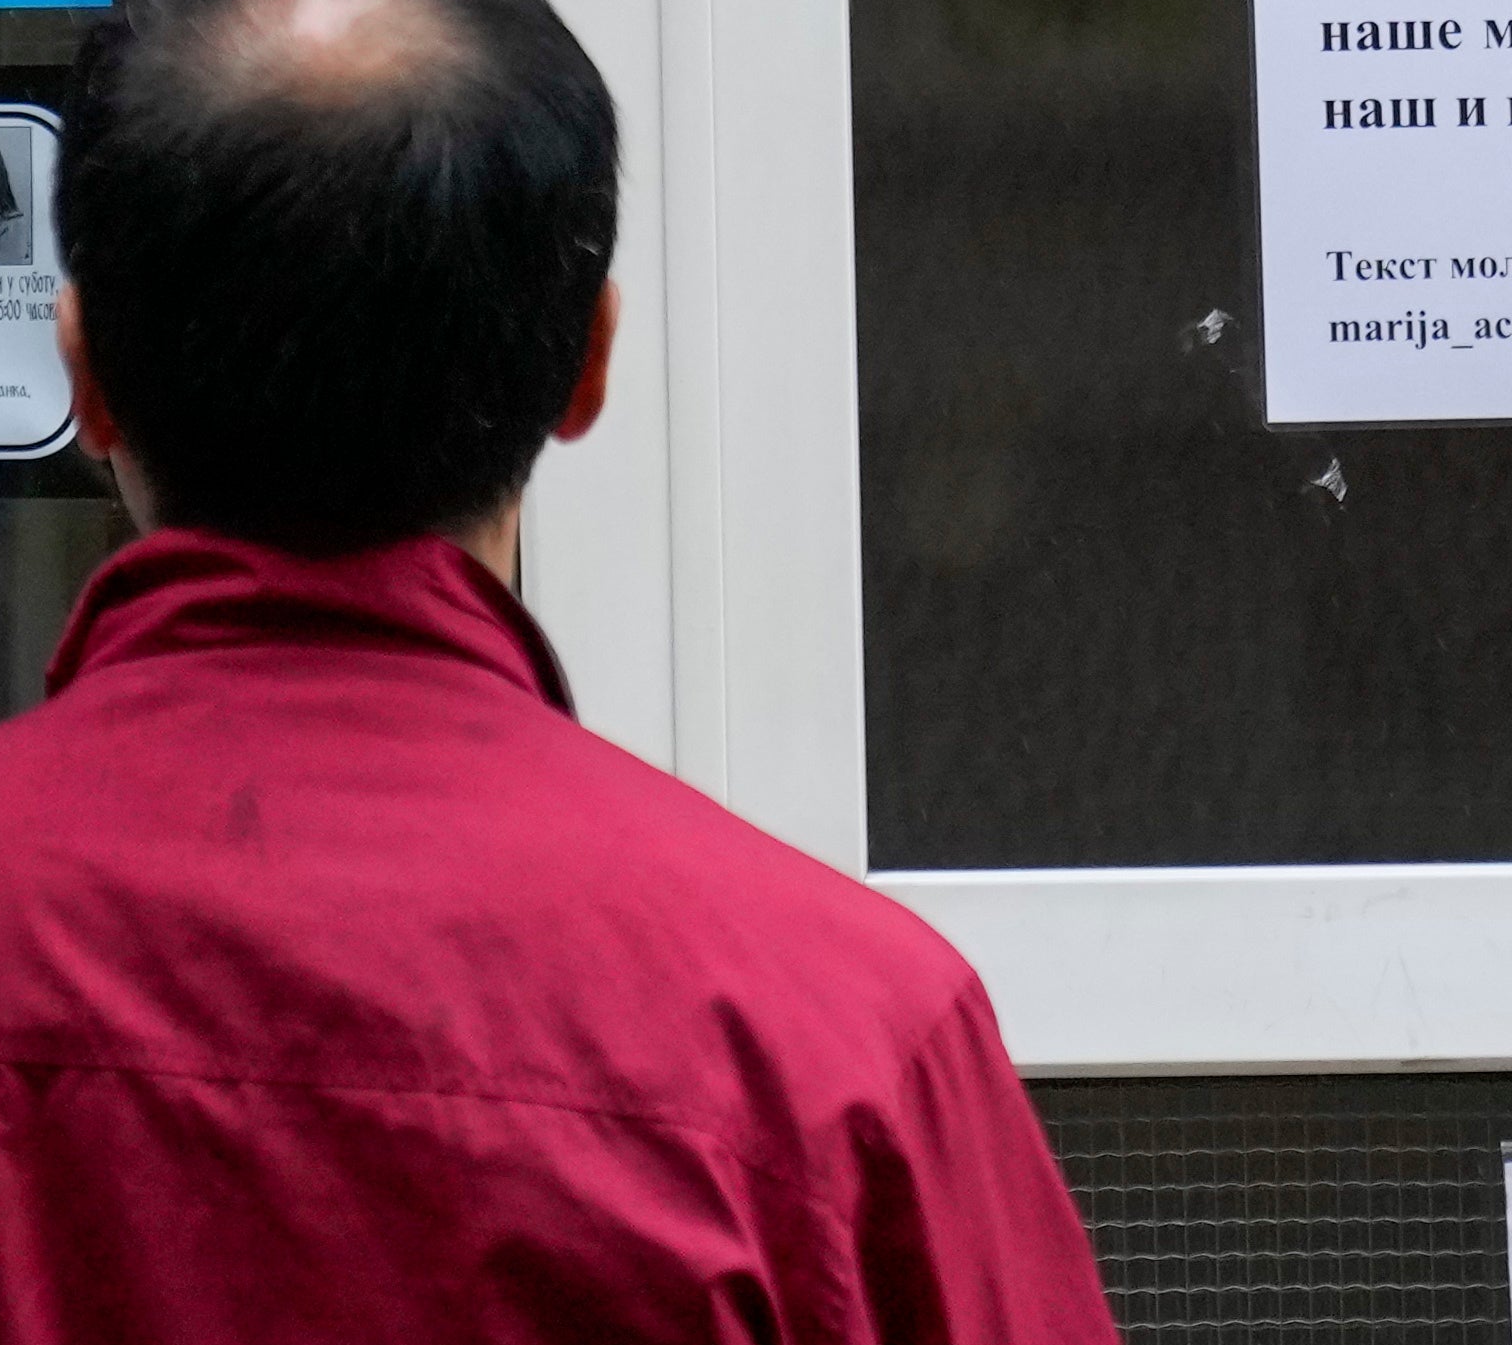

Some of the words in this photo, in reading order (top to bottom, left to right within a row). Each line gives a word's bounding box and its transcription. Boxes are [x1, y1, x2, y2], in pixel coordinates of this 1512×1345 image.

[1320, 19, 1461, 52] наше
[1323, 98, 1436, 130] наш
[1456, 97, 1485, 127] и
[1326, 250, 1437, 281] Текст
